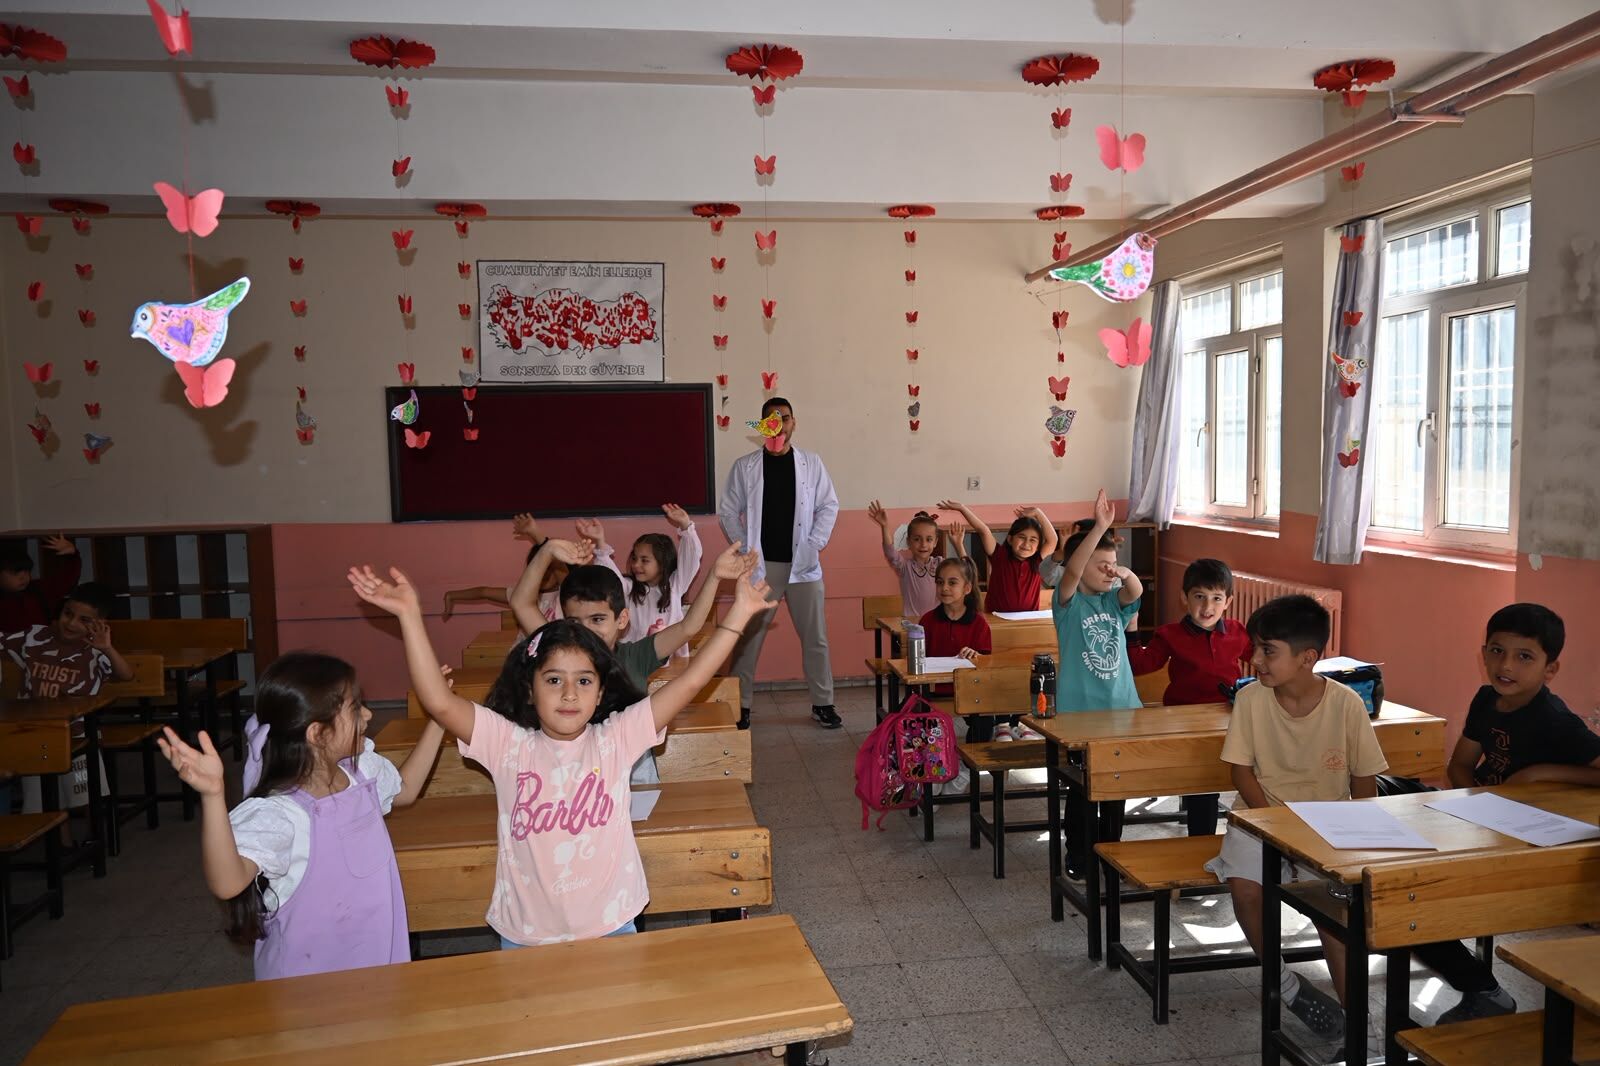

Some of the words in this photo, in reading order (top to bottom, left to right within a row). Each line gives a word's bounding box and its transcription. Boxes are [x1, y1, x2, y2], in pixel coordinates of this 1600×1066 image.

[485, 264, 568, 277] CUMHURİYET
[570, 266, 600, 277] EMİN
[603, 267, 652, 277] ELLERDE
[500, 365, 560, 376] SONSUZA
[563, 365, 588, 376] DEK
[589, 362, 645, 376] GÜVENDE
[32, 661, 80, 685] TRUST
[1082, 652, 1094, 671] OWN
[1094, 669, 1111, 680] THE
[39, 682, 59, 698] NO
[74, 769, 88, 783] NO
[73, 783, 88, 794] ON
[510, 771, 614, 841] Barbie
